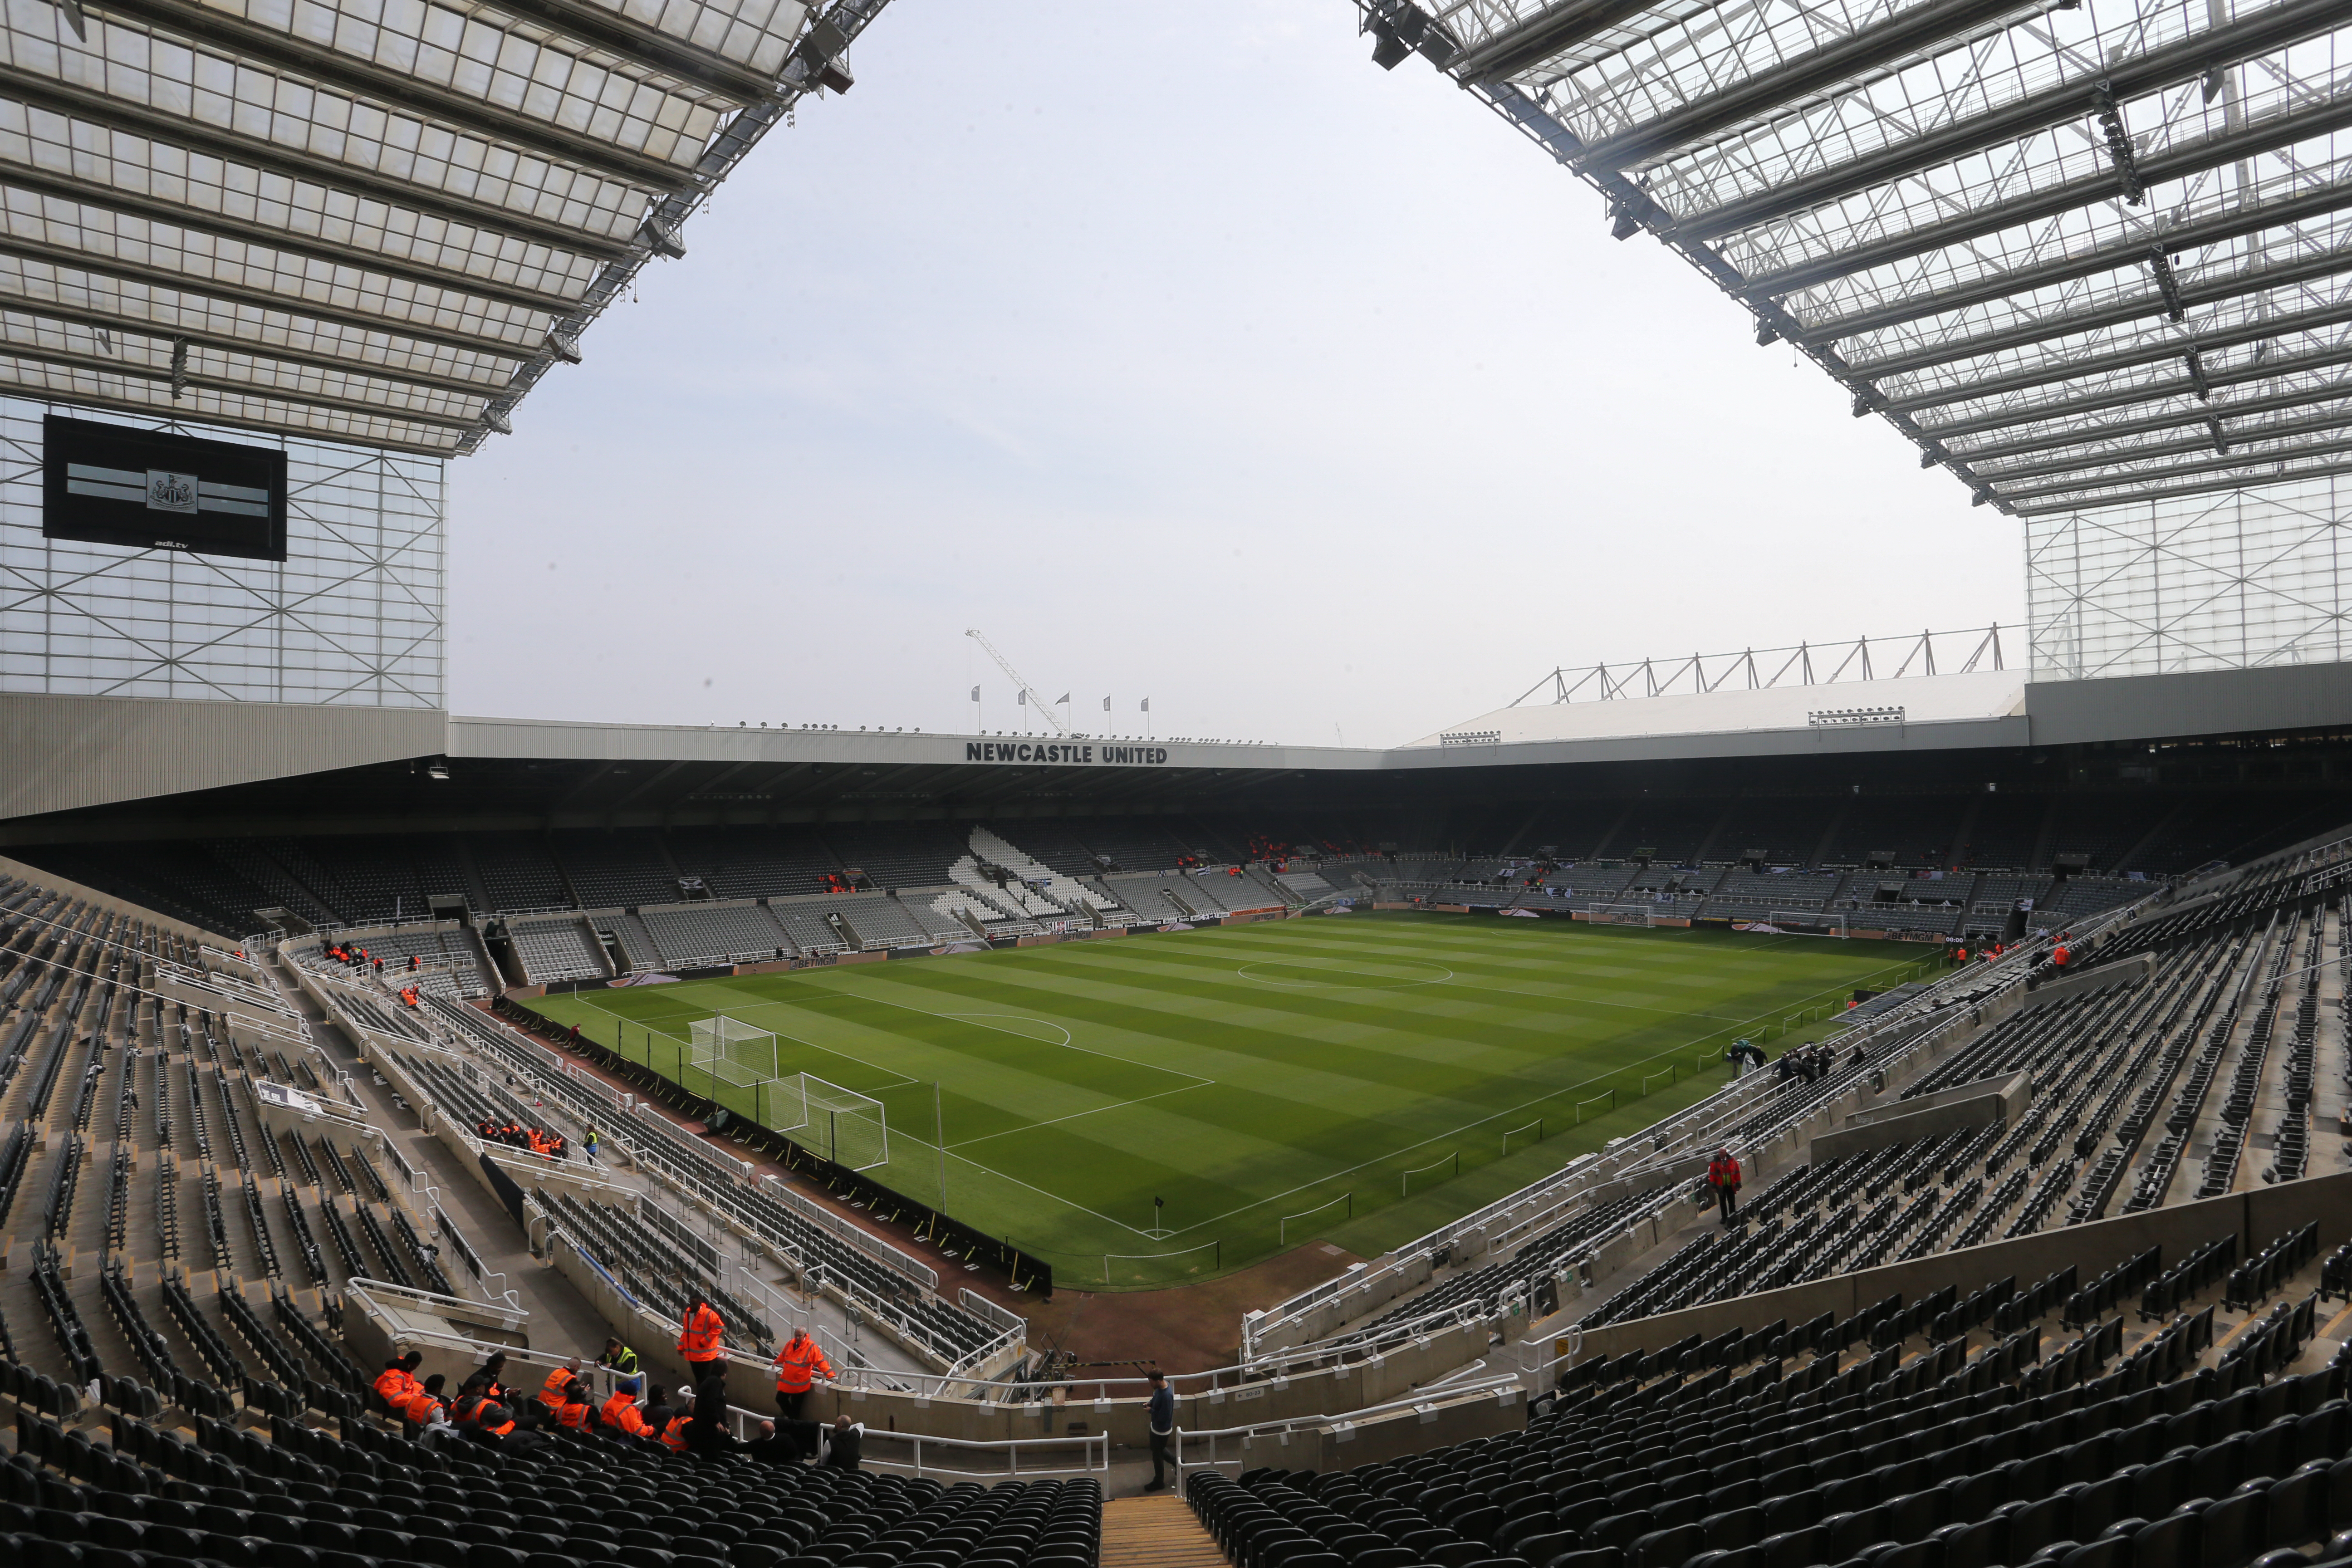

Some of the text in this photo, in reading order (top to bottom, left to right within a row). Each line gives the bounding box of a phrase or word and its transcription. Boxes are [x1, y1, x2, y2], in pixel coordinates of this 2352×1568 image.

[967, 742, 1167, 764] NEWCASTLE UNITED
[1254, 913, 1275, 921] BETMGM
[1617, 916, 1647, 924] BETMGM
[1063, 931, 1091, 941] BETMGM
[1891, 932, 1934, 942] BETMGM
[798, 956, 837, 968] BETMGM
